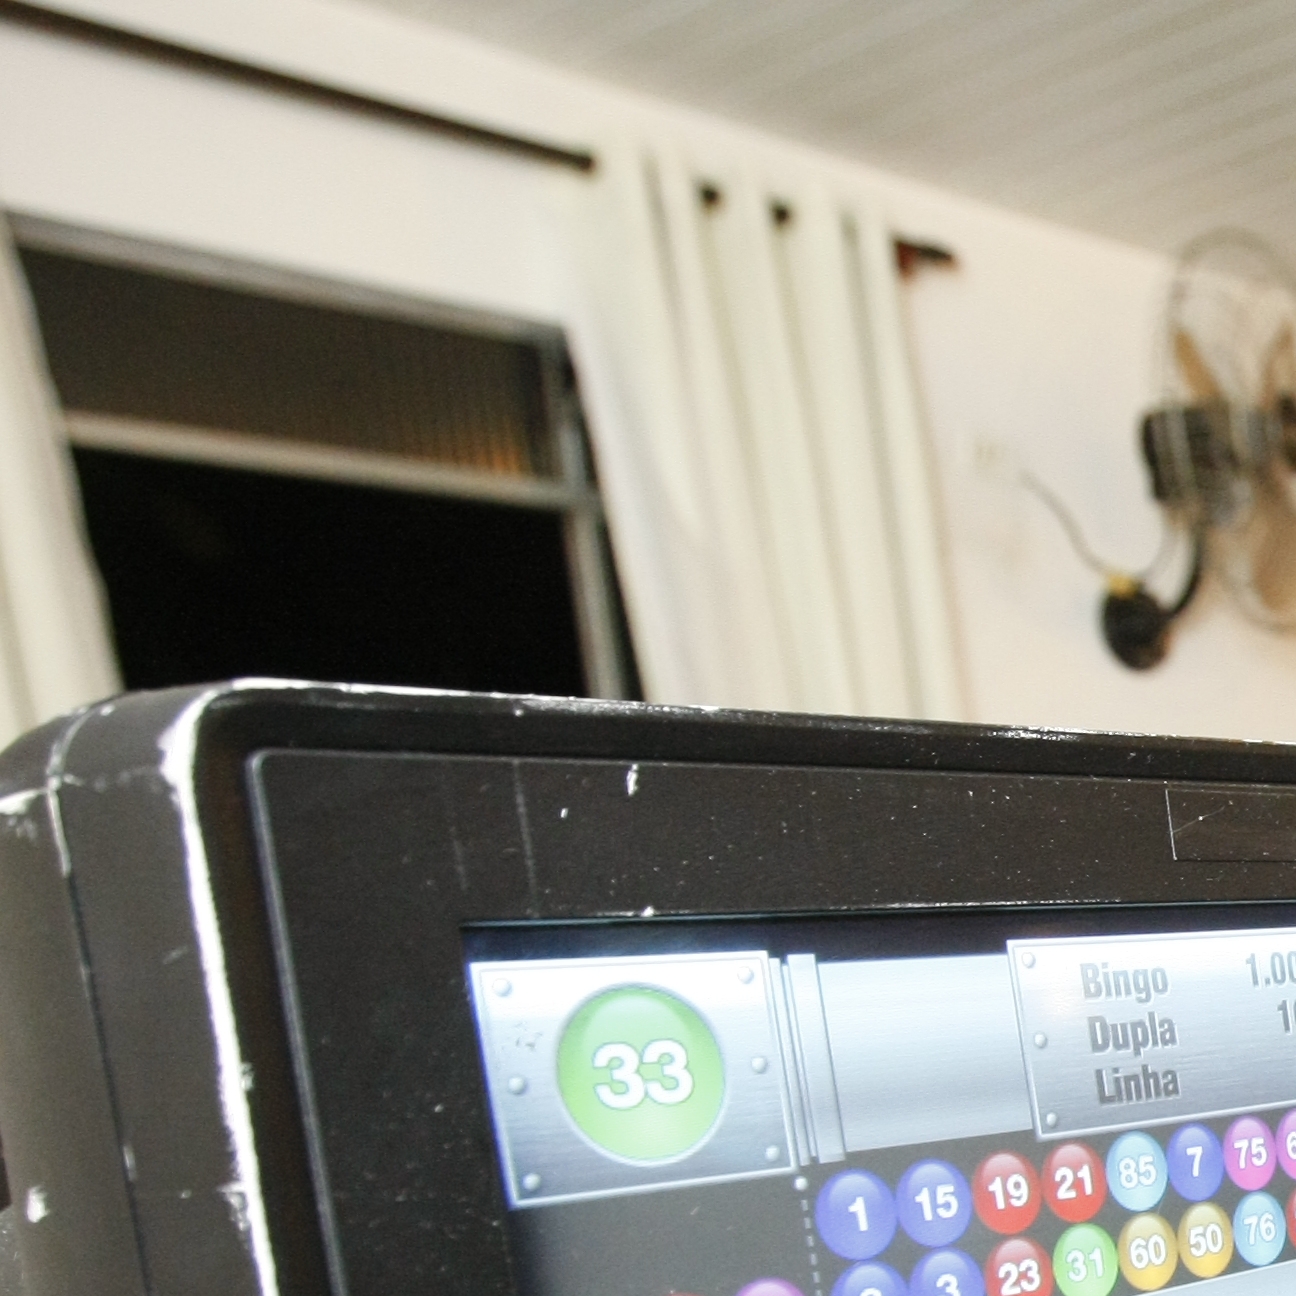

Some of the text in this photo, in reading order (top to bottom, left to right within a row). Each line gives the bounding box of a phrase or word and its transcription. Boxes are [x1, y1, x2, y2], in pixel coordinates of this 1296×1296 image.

[1080, 961, 1169, 1003] Bingo
[1088, 1011, 1177, 1057] Dupla
[591, 1038, 695, 1110] 33
[1096, 1064, 1181, 1104] Linha
[848, 1197, 868, 1231] 1
[915, 1185, 959, 1222] 15
[988, 1174, 1029, 1209] 19
[1055, 1164, 1092, 1200] 21
[1119, 1155, 1156, 1189] 85
[1186, 1146, 1202, 1177] 7
[1234, 1137, 1267, 1169] 75
[998, 1259, 1040, 1296] 23
[1066, 1247, 1104, 1282] 31
[1130, 1235, 1166, 1269] 60
[1188, 1223, 1222, 1257] 50
[1244, 1212, 1276, 1246] 76
